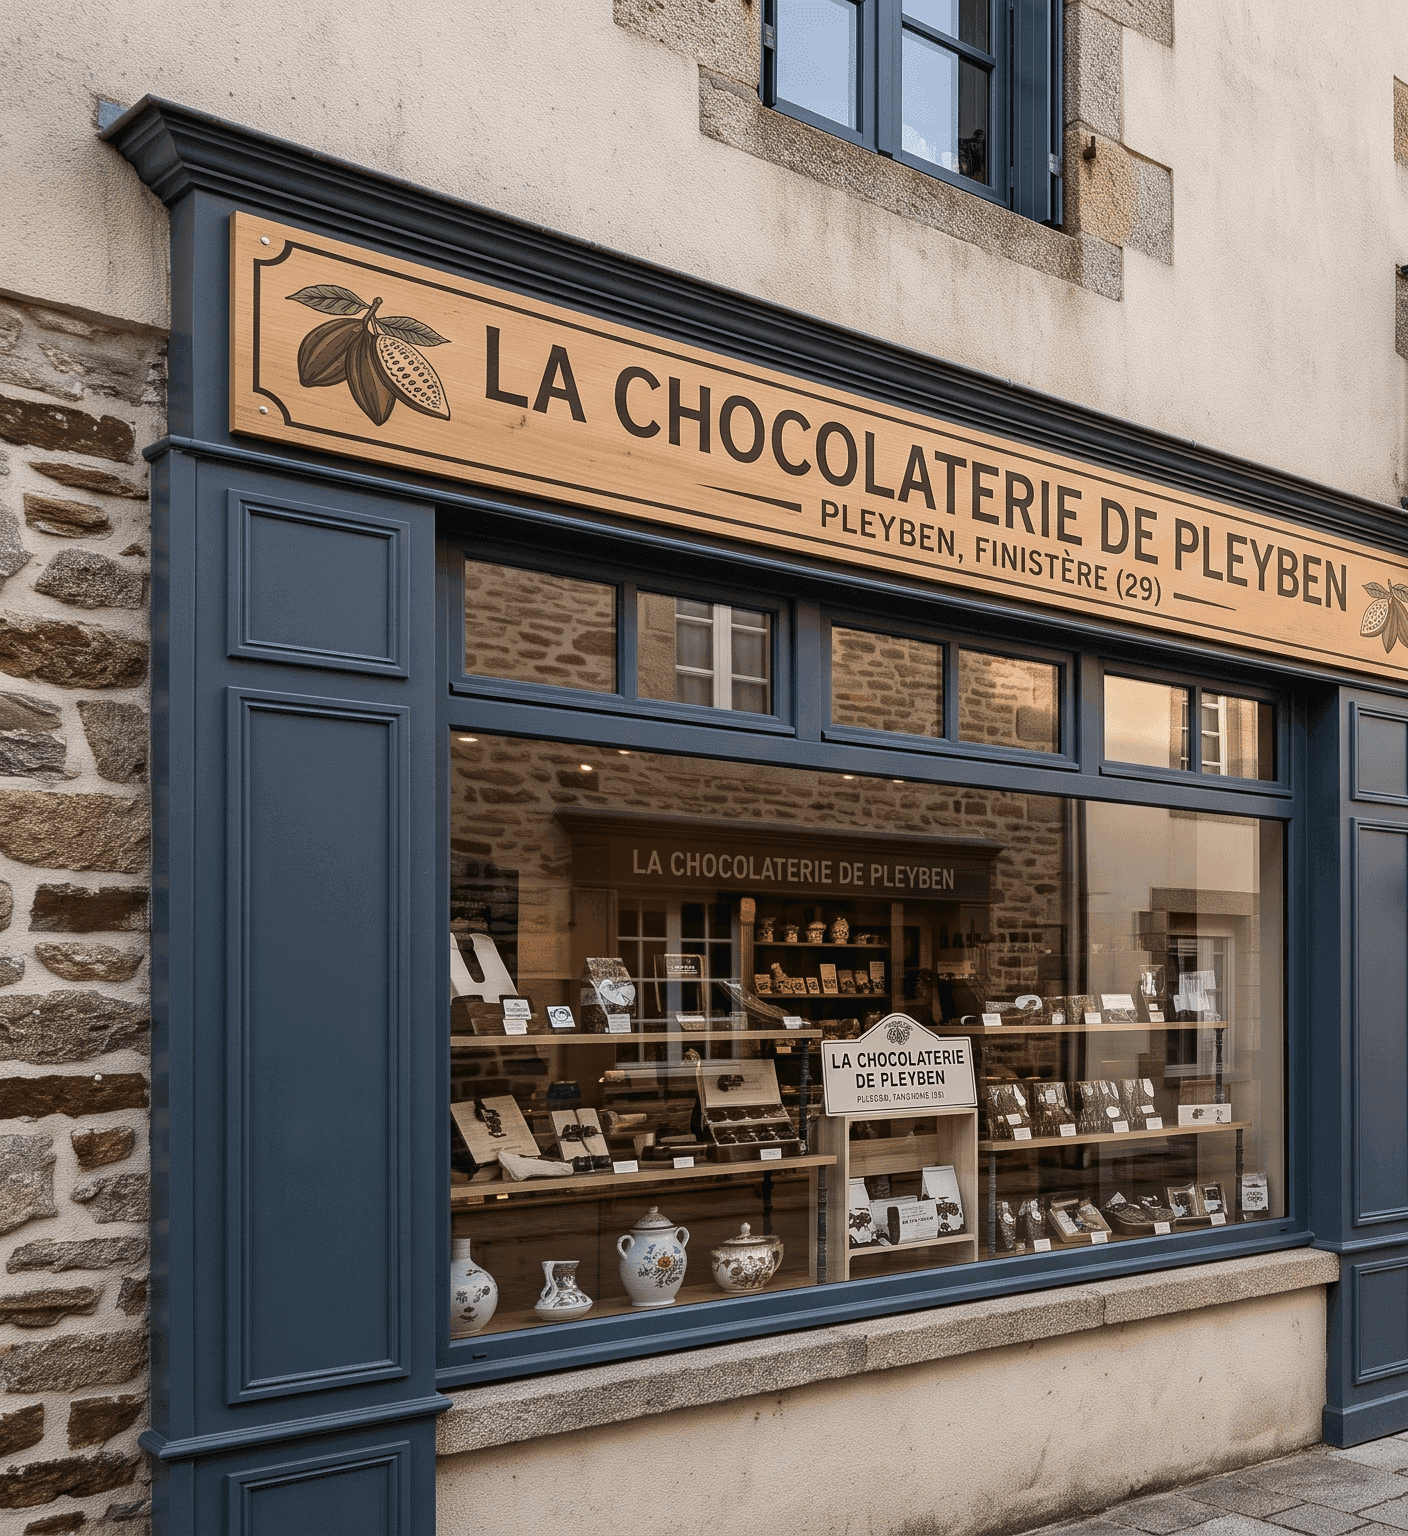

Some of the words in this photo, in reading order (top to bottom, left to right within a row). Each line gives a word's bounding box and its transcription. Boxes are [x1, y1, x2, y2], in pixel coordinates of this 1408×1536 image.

[485, 324, 588, 424] LA
[614, 366, 1083, 547] CHOCOLATERIE
[1100, 498, 1159, 566] DE
[1174, 518, 1348, 612] PLEYBEN
[821, 498, 965, 565] PLEYBEN,
[975, 536, 1108, 593] FINISTÈRE
[1116, 571, 1163, 608] (29)
[633, 849, 663, 875] LA
[670, 851, 833, 884] CHOCOLATERIE
[839, 861, 864, 886] DE
[870, 863, 954, 890] PLEYBEN
[831, 1053, 852, 1069] LA
[857, 1049, 965, 1069] CHOCOLATERIE
[856, 1073, 876, 1089] DE
[880, 1070, 945, 1088] PLEYBEN
